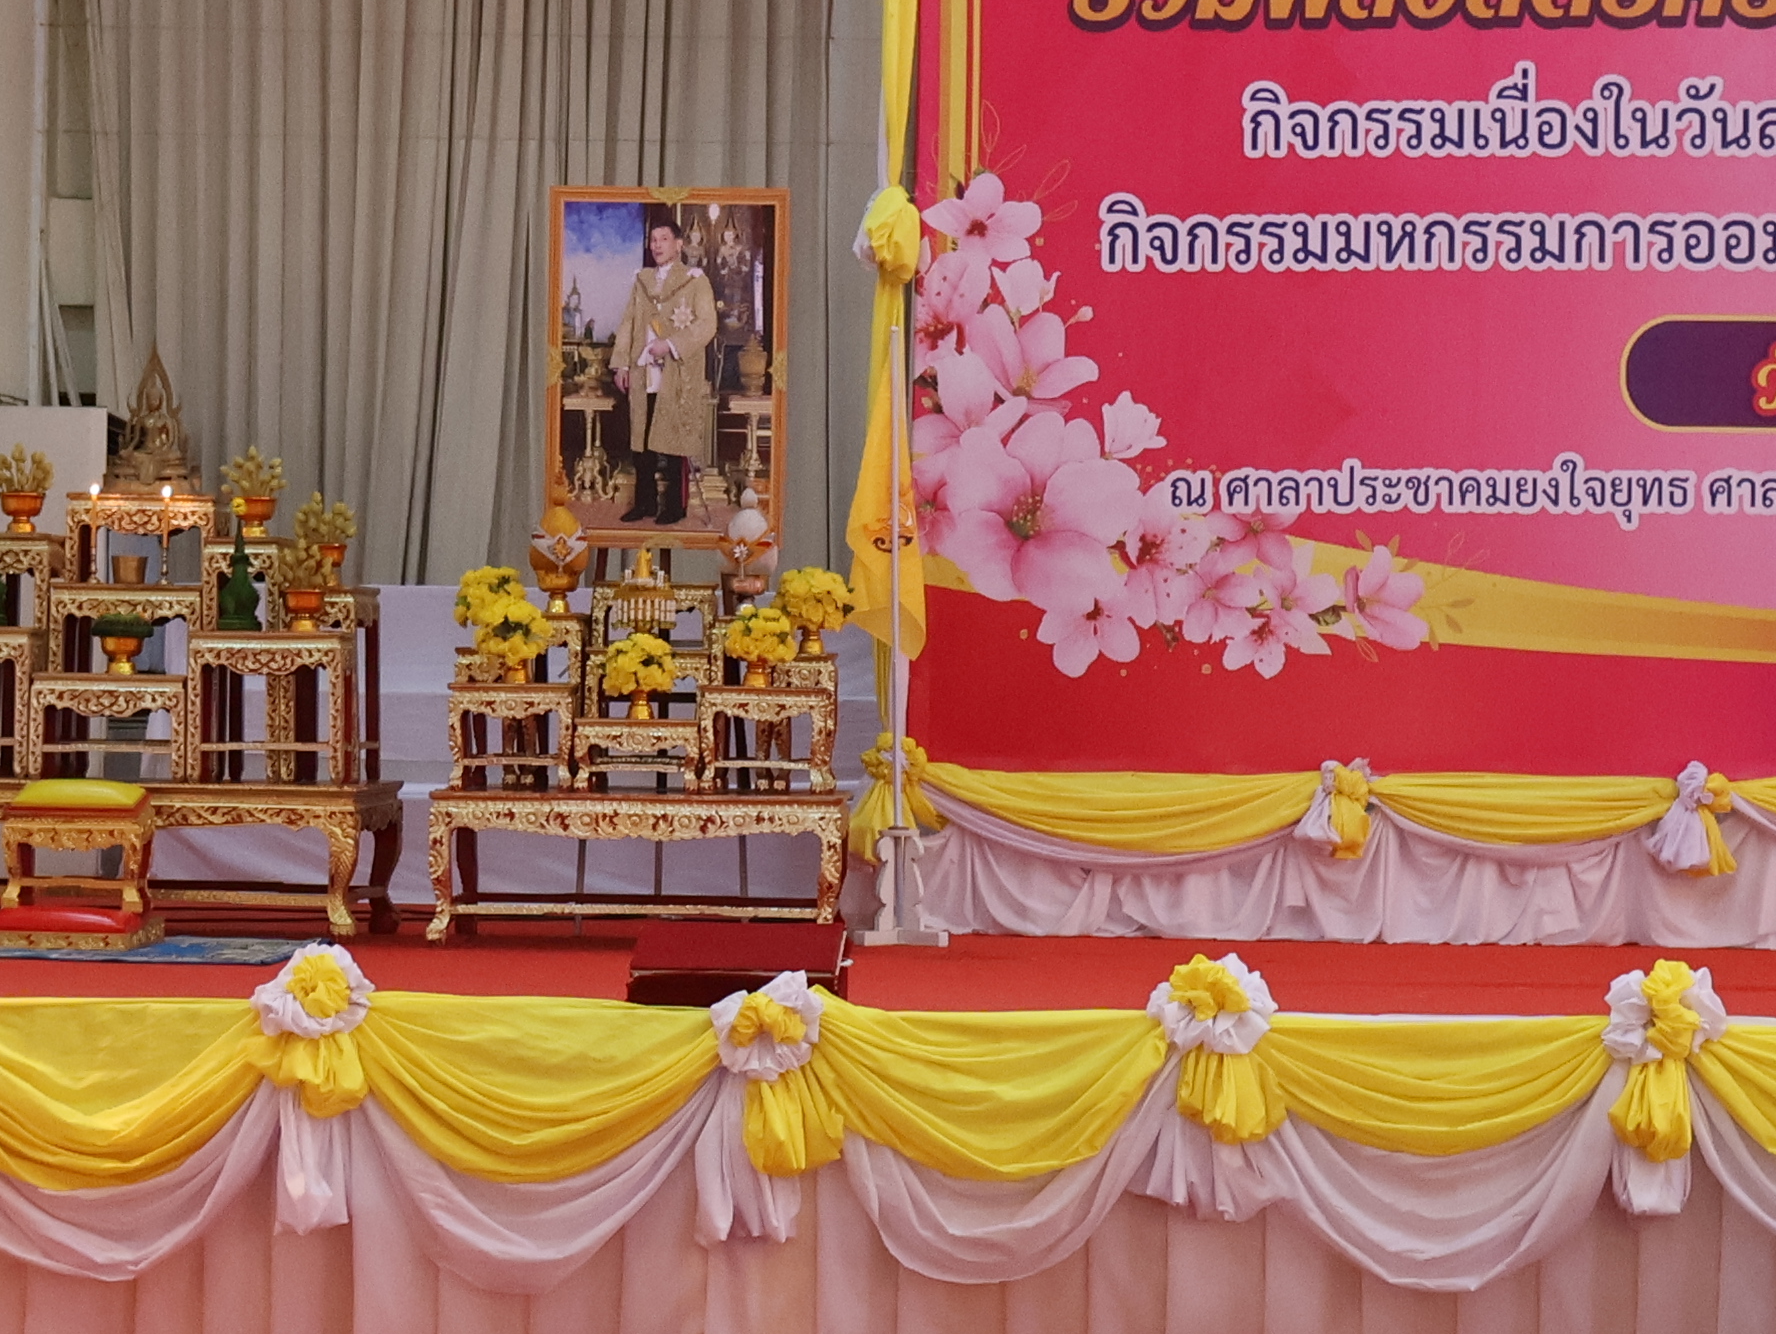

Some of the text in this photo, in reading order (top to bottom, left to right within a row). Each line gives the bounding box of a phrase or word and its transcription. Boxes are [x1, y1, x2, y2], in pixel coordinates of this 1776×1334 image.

[1169, 474, 1208, 509] ณ
[1225, 459, 1690, 524] ศาลาประชาคมยงใจยุทธ
